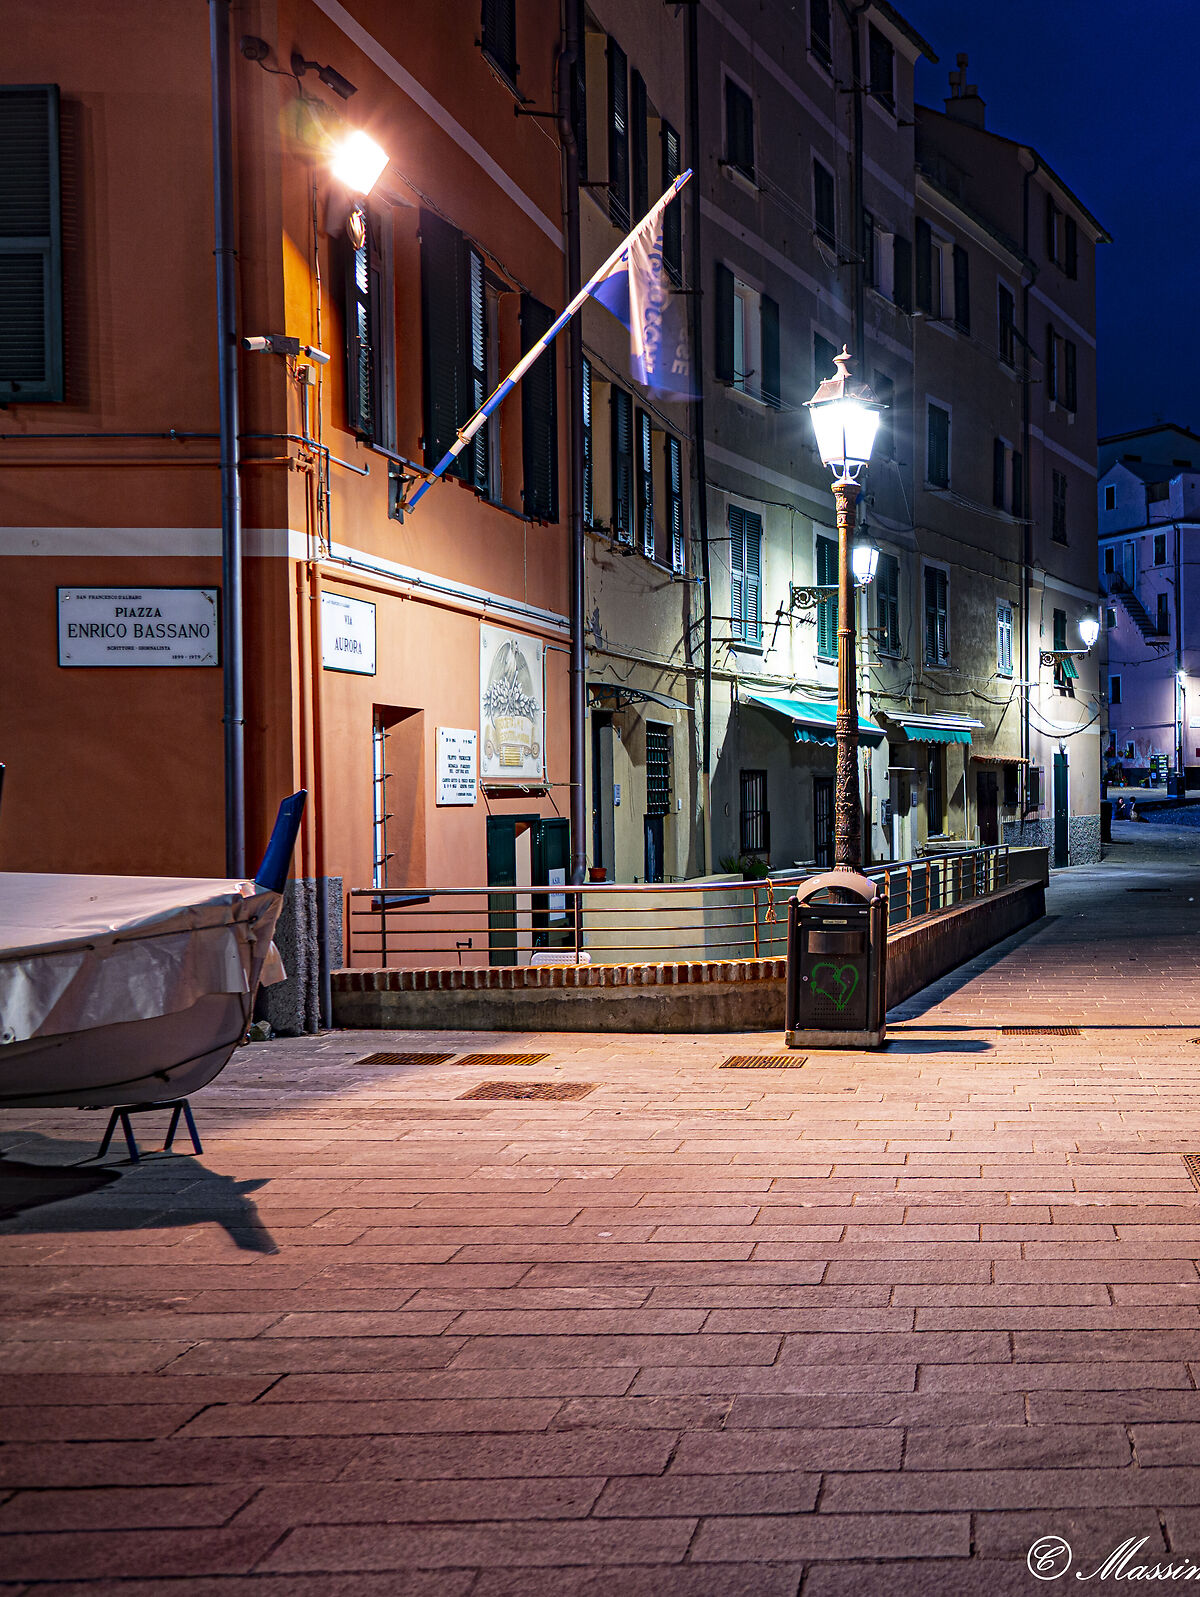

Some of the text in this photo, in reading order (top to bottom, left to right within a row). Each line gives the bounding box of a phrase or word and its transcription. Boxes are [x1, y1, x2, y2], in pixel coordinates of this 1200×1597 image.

[115, 607, 162, 618] PIAZZA
[344, 614, 353, 625] VIA
[67, 623, 210, 638] ENRICO BASSANO
[334, 637, 363, 655] AURORA
